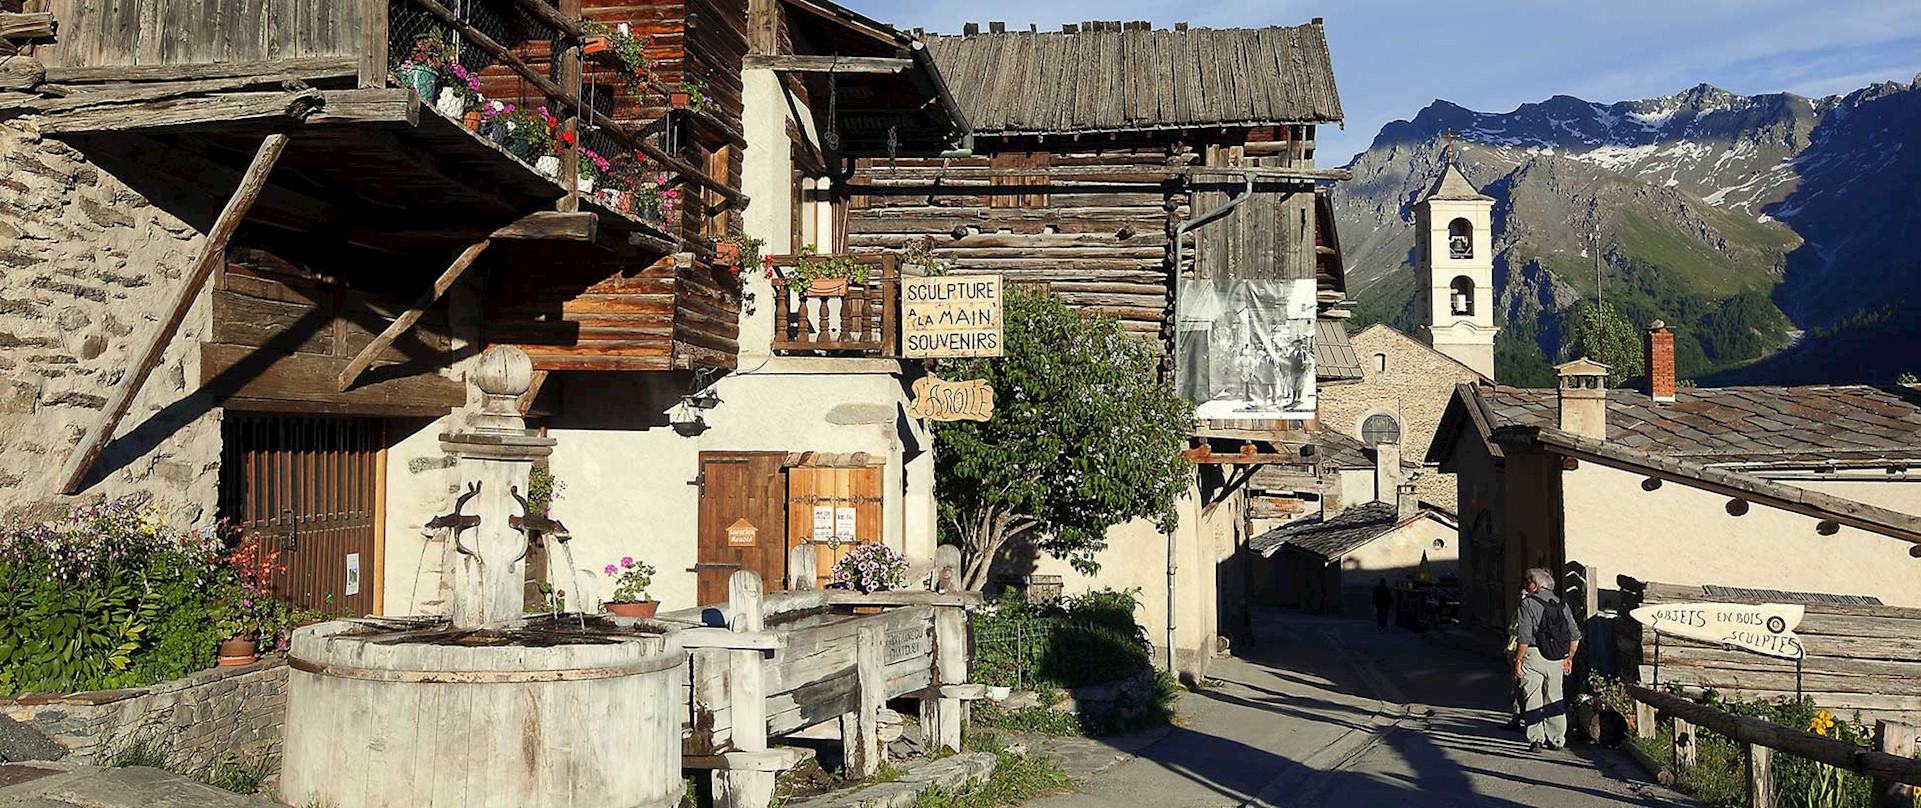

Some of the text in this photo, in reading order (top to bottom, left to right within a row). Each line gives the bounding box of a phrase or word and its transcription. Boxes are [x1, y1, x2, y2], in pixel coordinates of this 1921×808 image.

[908, 282, 994, 300] SCULPTURE
[908, 308, 990, 326] A LA MAIN
[908, 333, 997, 350] SOUVENIRS
[1656, 610, 1764, 627] OBJETS EN BOIS
